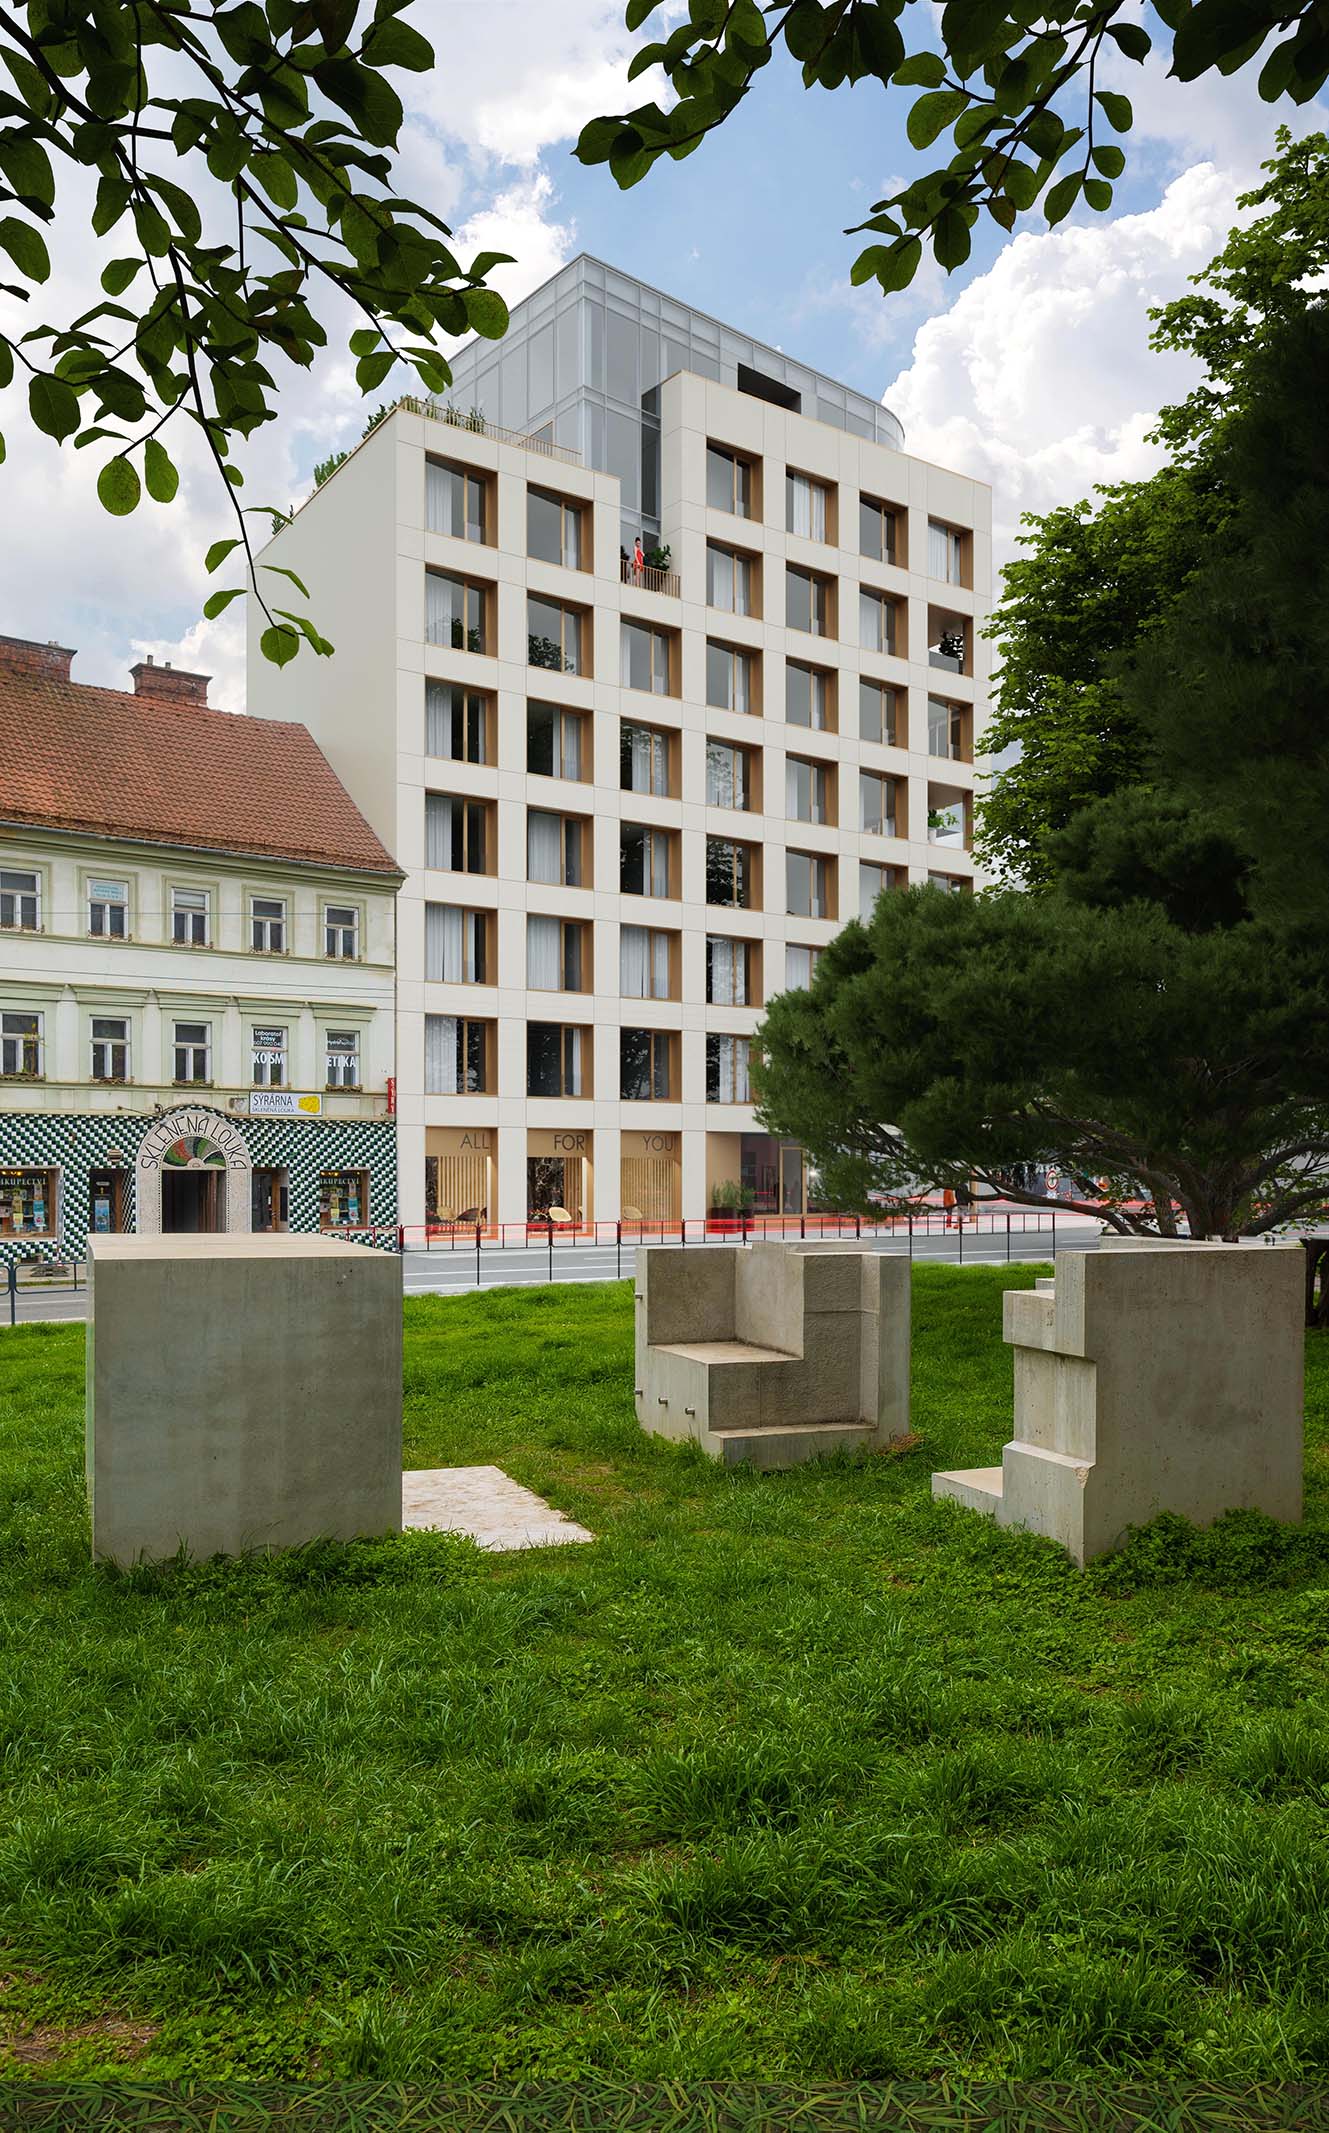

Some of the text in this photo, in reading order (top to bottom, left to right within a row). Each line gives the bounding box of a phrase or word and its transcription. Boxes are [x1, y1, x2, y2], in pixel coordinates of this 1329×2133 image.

[253, 1093, 293, 1106] SÝRÁRNA
[210, 1122, 247, 1170] LOUKA
[460, 1132, 490, 1149] ALL
[554, 1134, 585, 1151] FOR
